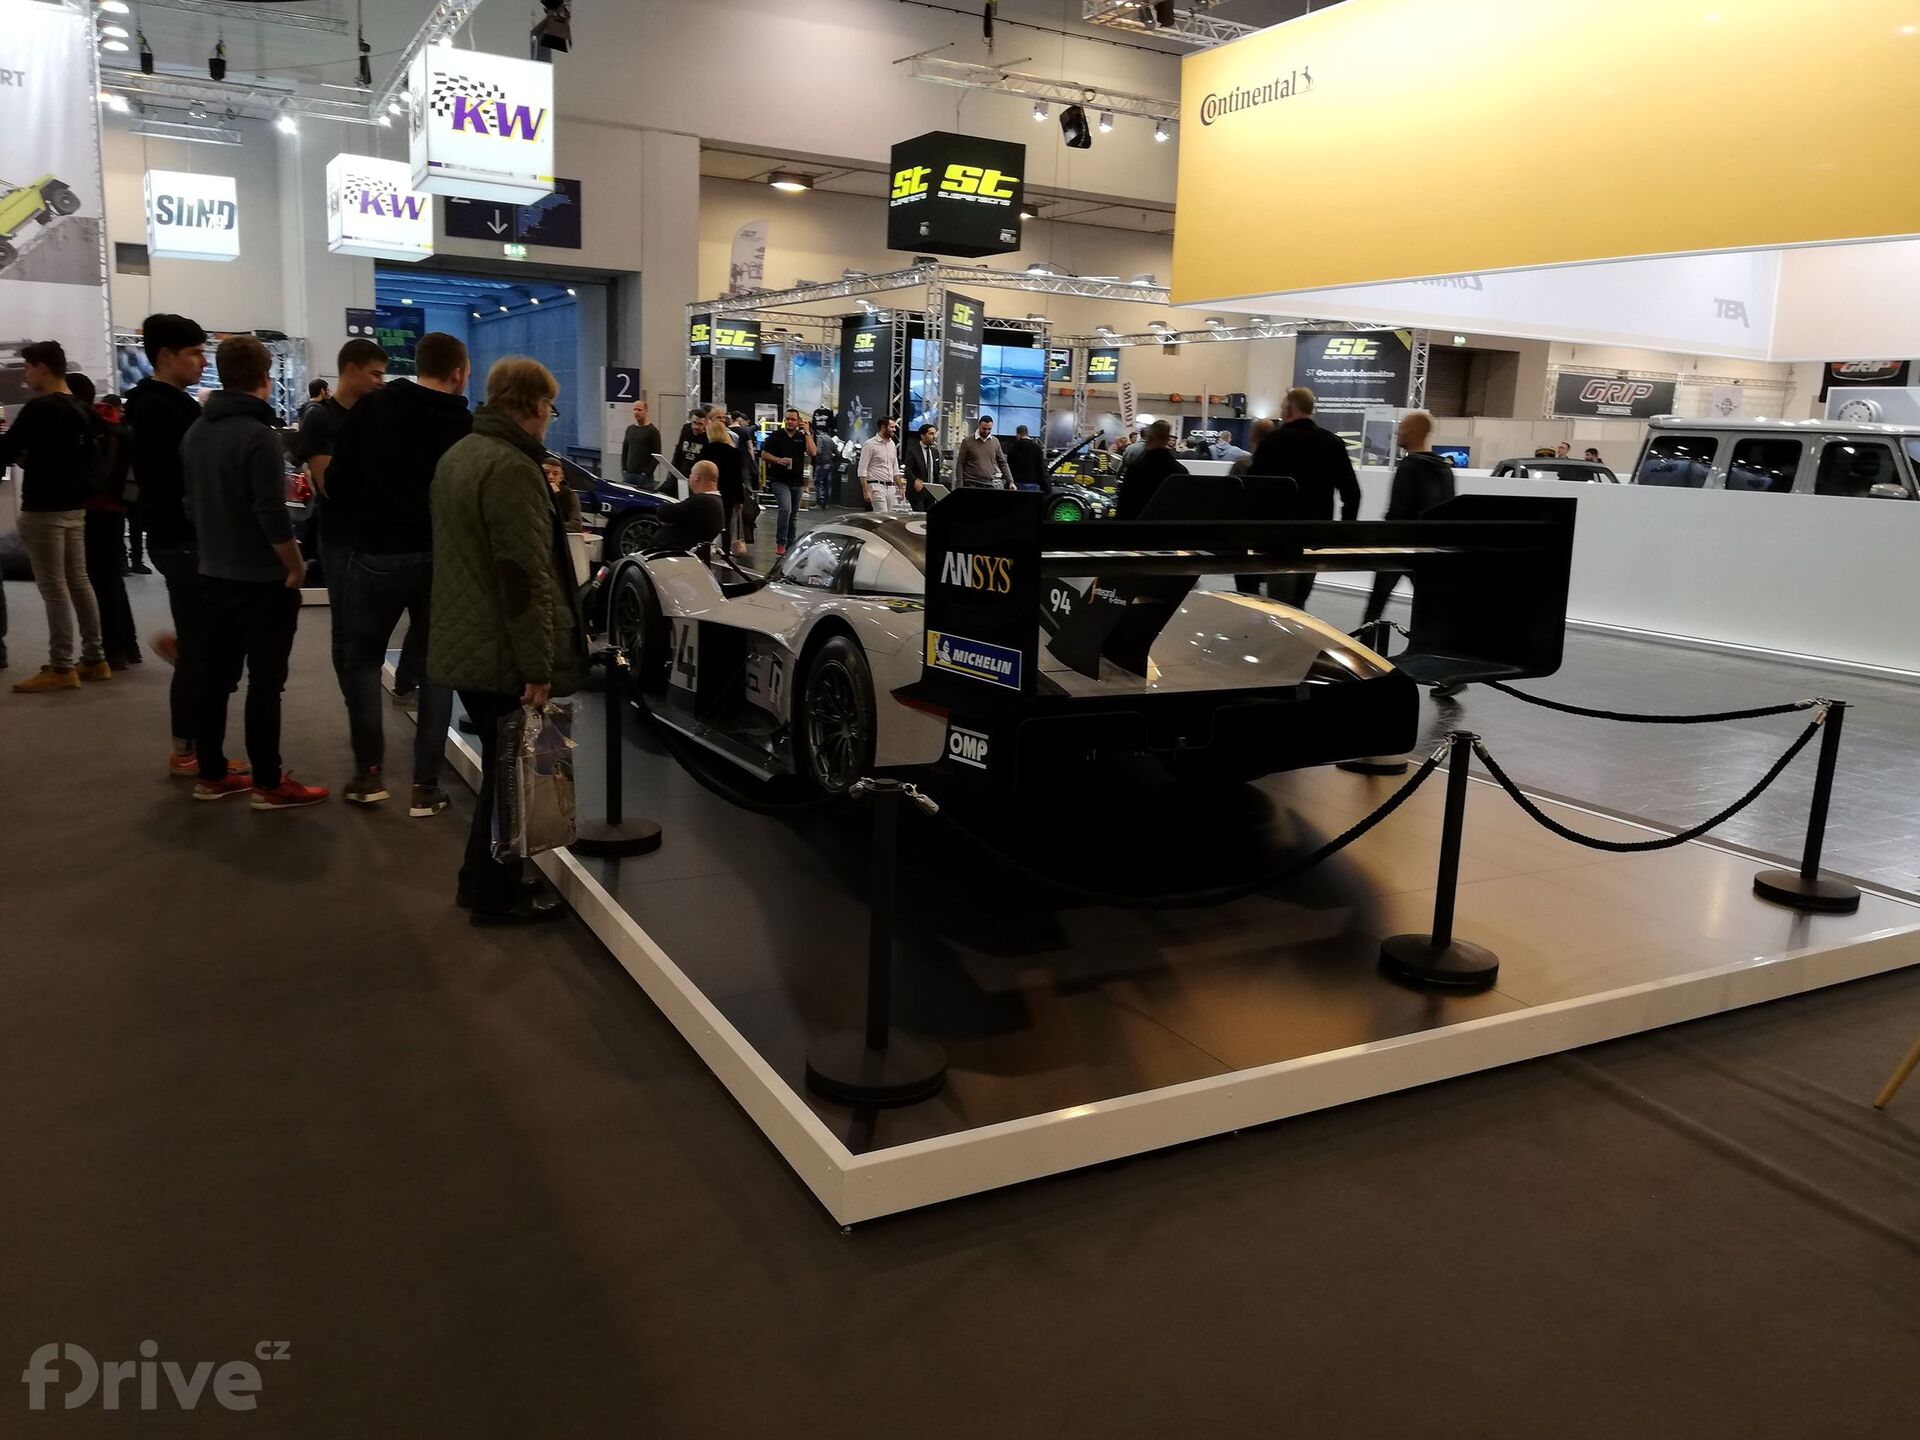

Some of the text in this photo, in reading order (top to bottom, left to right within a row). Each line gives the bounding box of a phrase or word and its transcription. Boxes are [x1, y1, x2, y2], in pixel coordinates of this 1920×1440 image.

[1200, 70, 1296, 126] Continental
[452, 95, 547, 143] KW
[359, 190, 427, 222] KW
[616, 373, 633, 399] 2
[1578, 379, 1654, 406] GRIP
[941, 551, 1012, 594] ANSYS
[1050, 588, 1072, 615] 94
[952, 648, 1013, 676] MICHELIN
[949, 732, 988, 761] OMP
